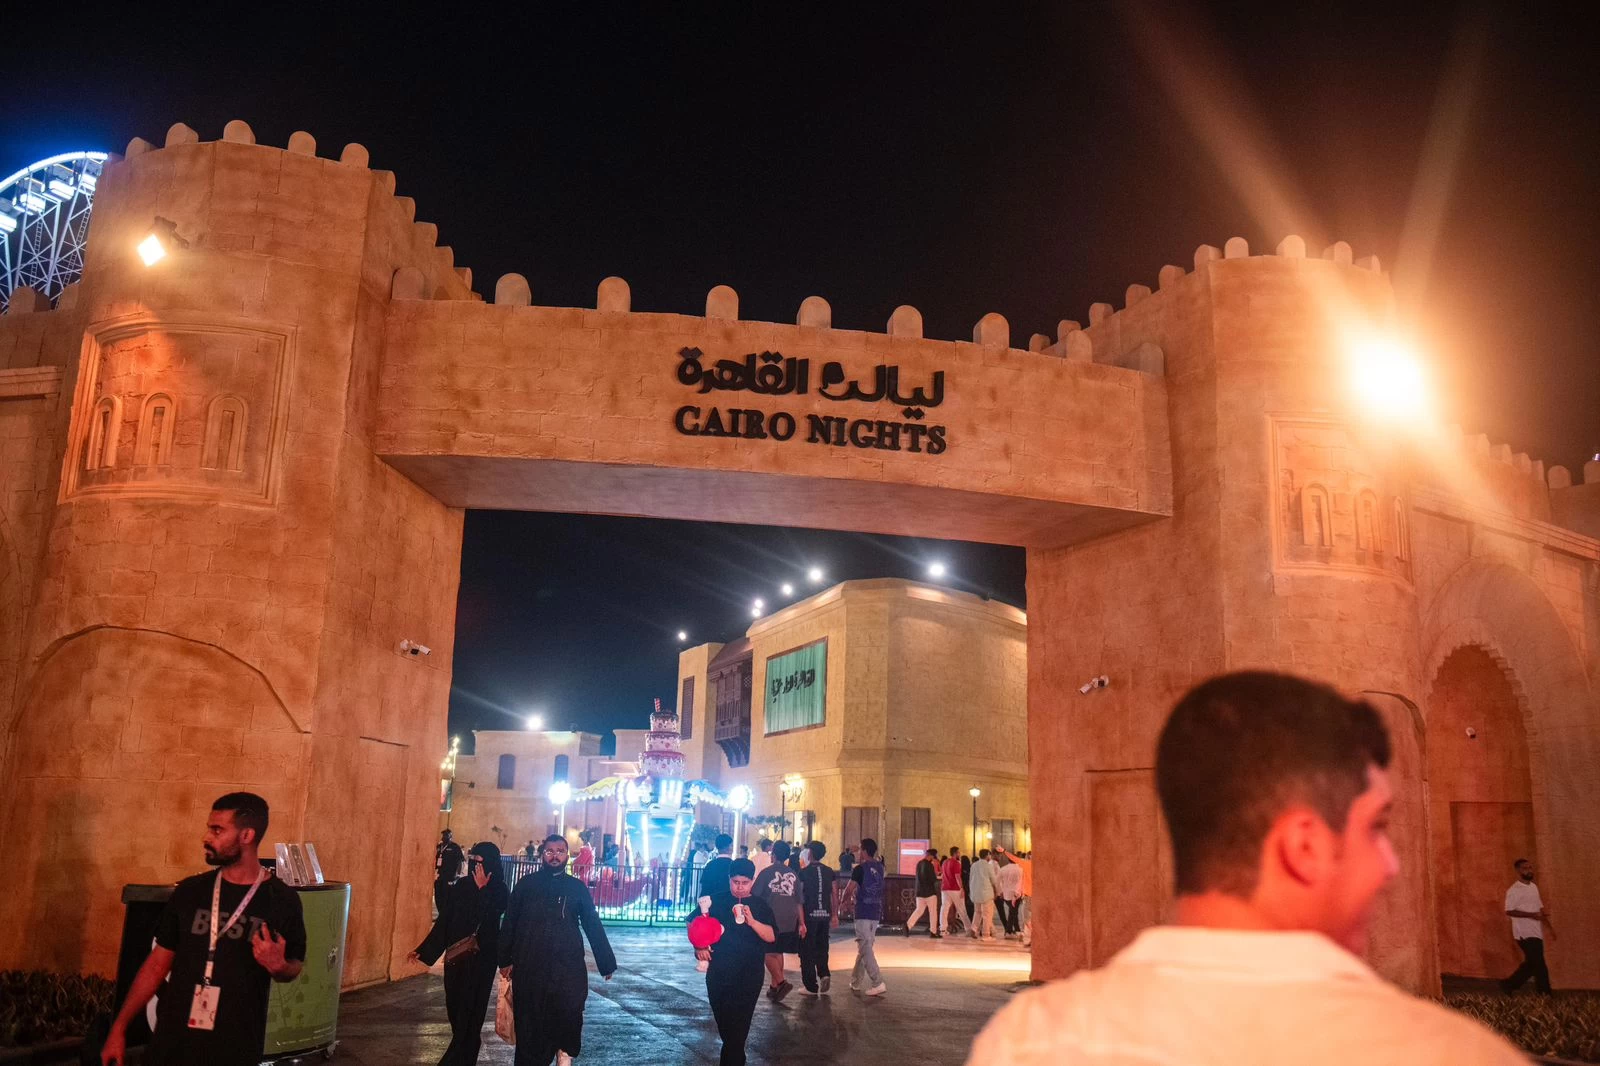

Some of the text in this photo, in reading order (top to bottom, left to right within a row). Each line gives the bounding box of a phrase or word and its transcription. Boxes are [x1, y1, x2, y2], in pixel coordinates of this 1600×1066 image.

[678, 346, 809, 395] القاهرة
[675, 405, 948, 455] CAIRO NIGHTS
